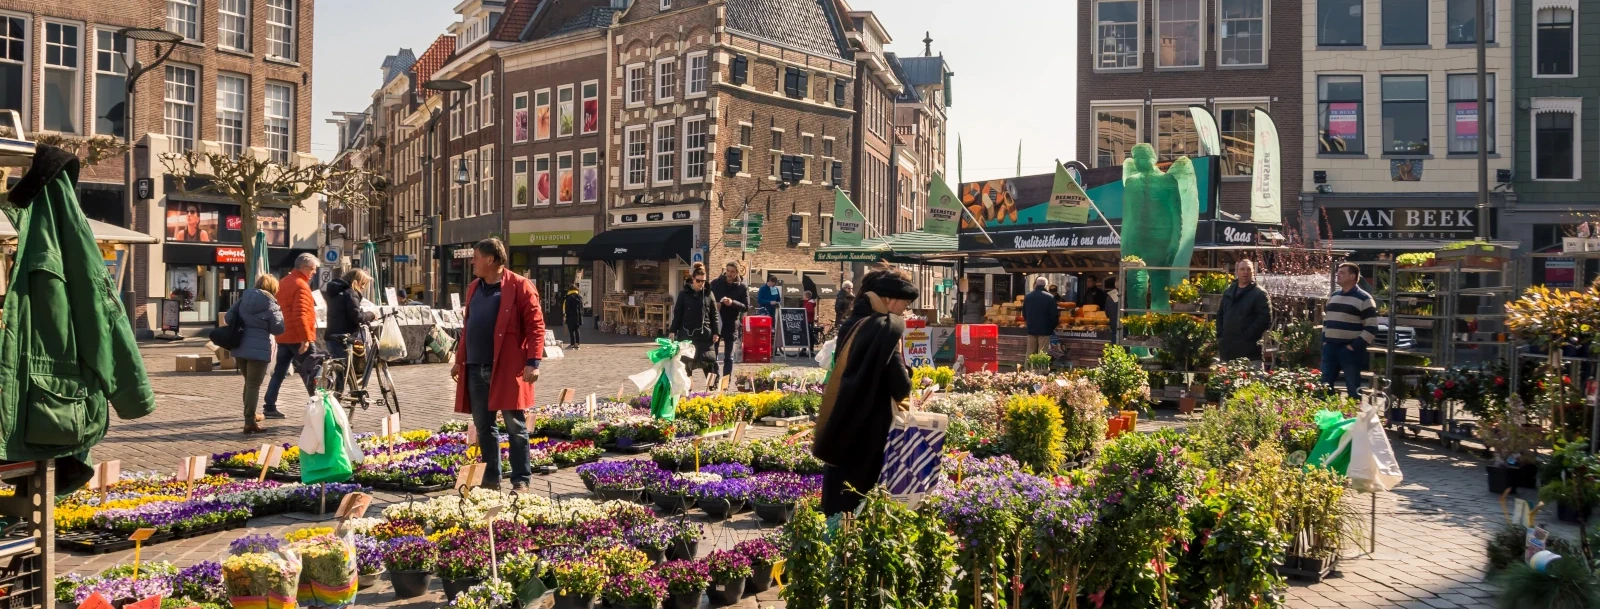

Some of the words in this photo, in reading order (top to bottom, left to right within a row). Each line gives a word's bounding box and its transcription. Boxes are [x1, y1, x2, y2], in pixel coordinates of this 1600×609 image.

[1343, 209, 1395, 227] VAN
[1405, 209, 1474, 227] BEEK
[1014, 234, 1069, 249] Kwaliteitskaas
[1071, 233, 1079, 246] is
[1080, 236, 1094, 246] ons
[1223, 226, 1252, 243] Kaas
[908, 347, 927, 355] KAAS
